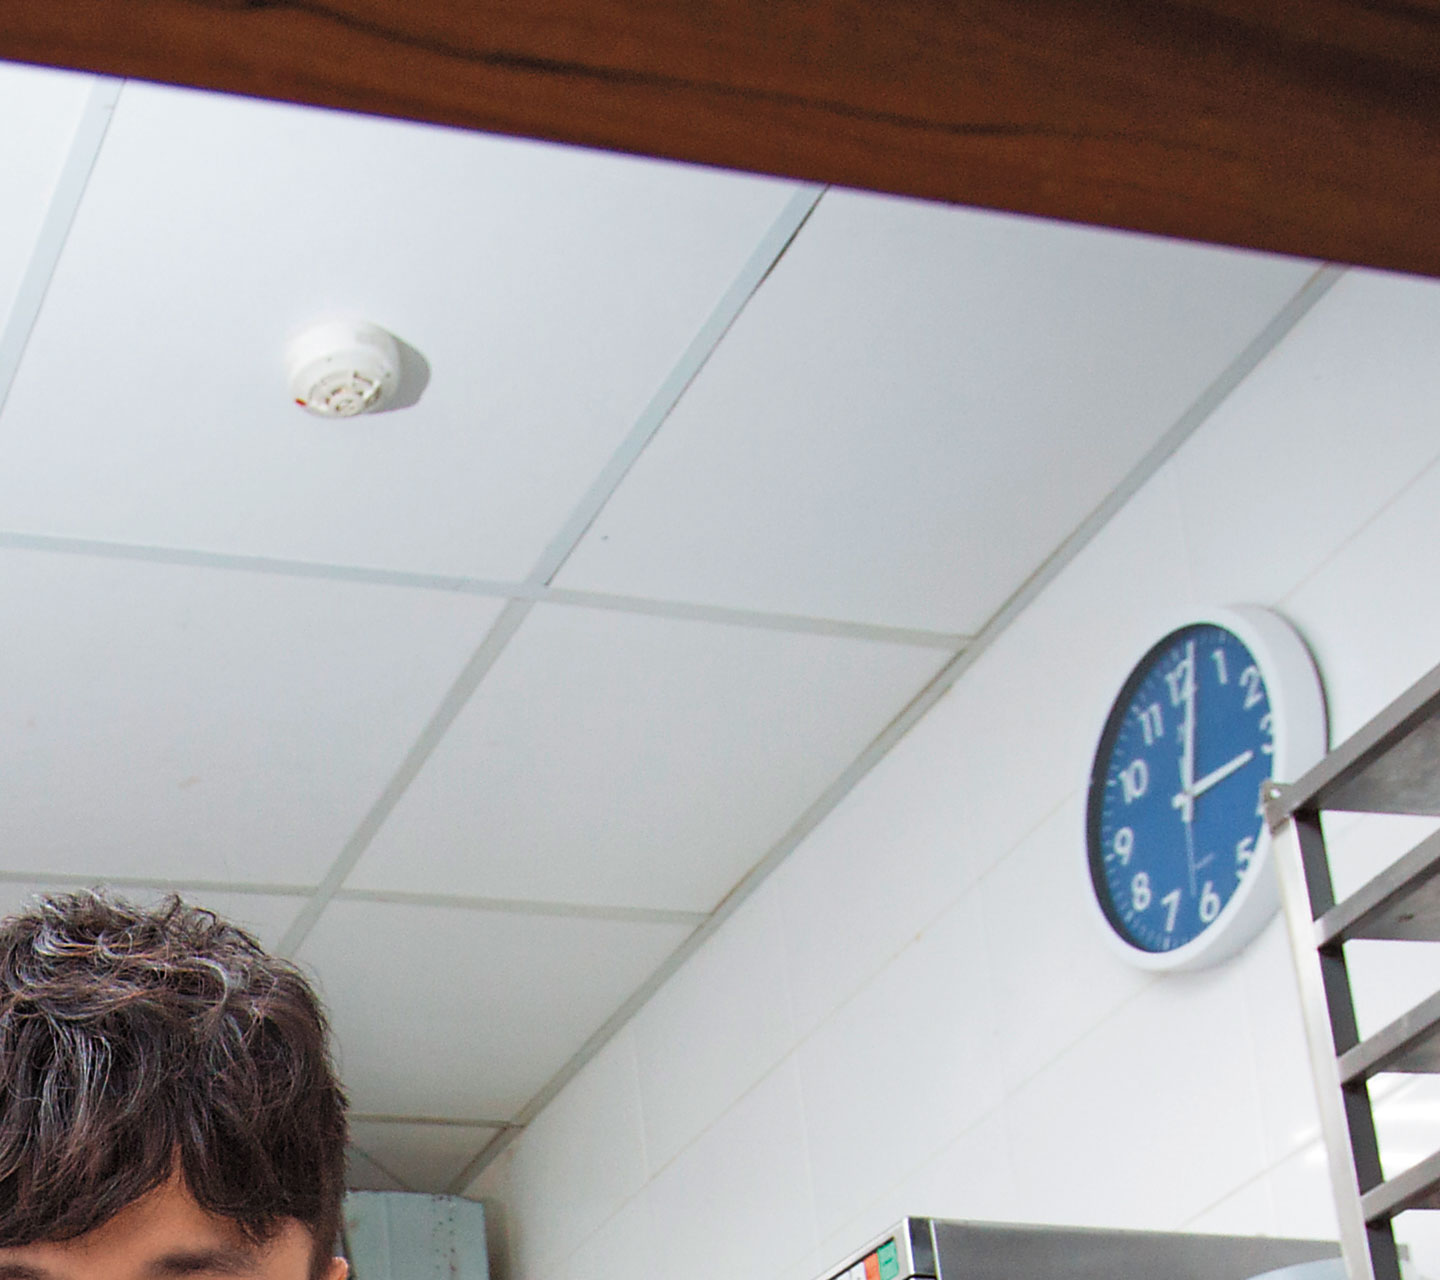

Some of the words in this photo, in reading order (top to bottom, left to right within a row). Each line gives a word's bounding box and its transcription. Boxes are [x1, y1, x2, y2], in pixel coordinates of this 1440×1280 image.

[1211, 650, 1227, 685] 1
[1239, 665, 1264, 710] 2
[1138, 703, 1164, 746] 11
[1119, 759, 1148, 804] 10
[1113, 826, 1134, 866] 9
[1131, 872, 1151, 912] 8
[1161, 888, 1182, 933] 7
[1199, 880, 1220, 923] 6
